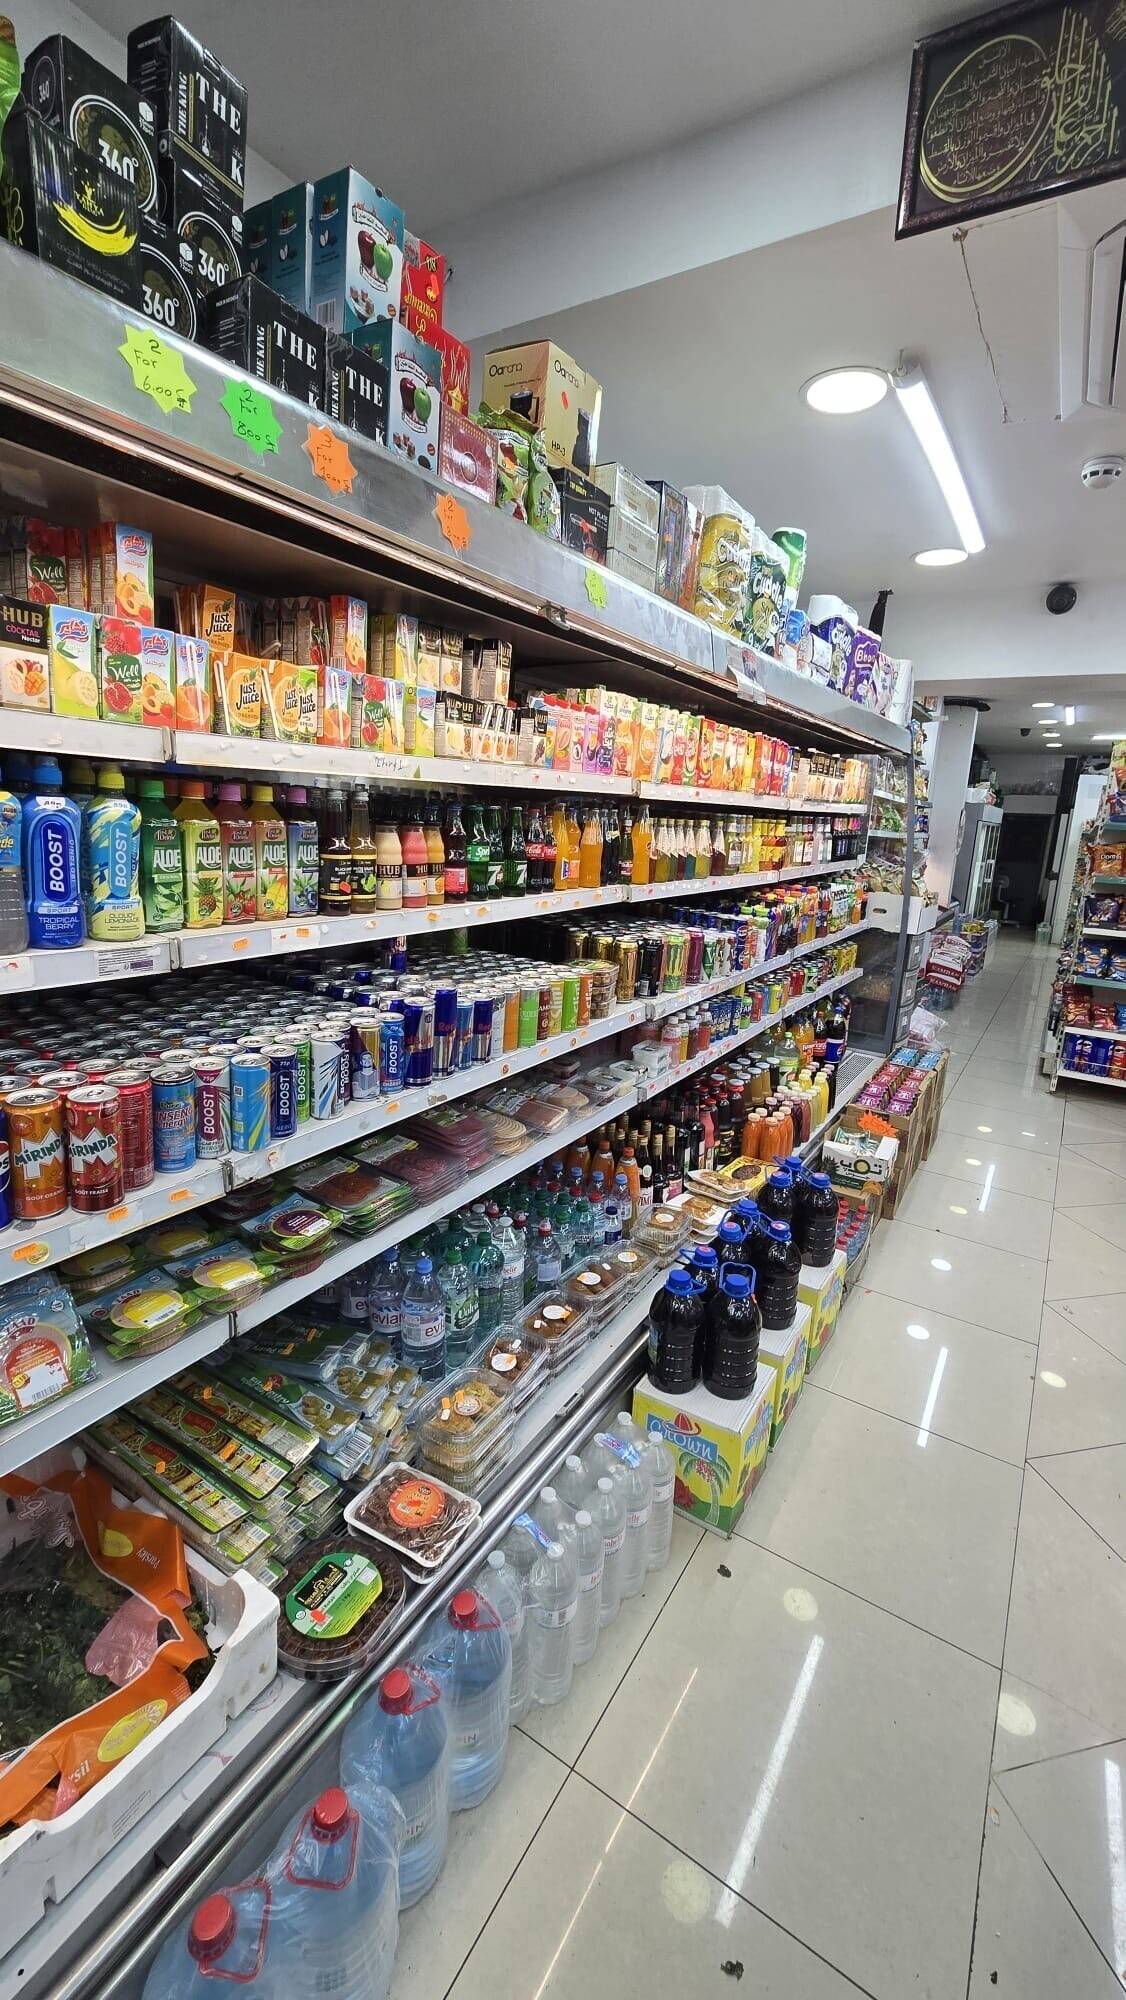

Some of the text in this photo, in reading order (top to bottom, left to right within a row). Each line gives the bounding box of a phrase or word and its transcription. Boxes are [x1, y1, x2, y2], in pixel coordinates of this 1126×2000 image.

[195, 71, 241, 136] THE
[197, 248, 229, 288] 360°
[141, 284, 181, 329] 360°
[149, 339, 162, 355] 2
[273, 320, 317, 370] THE
[134, 349, 158, 369] For
[242, 389, 254, 404] 2
[346, 365, 383, 407] THE
[32, 566, 64, 580] Well
[3, 605, 44, 628] HUB
[210, 611, 230, 628] Just
[205, 621, 233, 637] Juice
[109, 666, 140, 682] Well
[236, 692, 260, 711] Juice
[47, 829, 66, 893] BOOST
[115, 829, 128, 887] BOOST
[153, 848, 182, 870] ALOE
[196, 845, 221, 867] ALOE
[229, 846, 255, 867] ALOE
[263, 844, 287, 864] ALOE
[298, 844, 319, 863] ALOE
[380, 865, 400, 875] HUB
[46, 923, 76, 931] BERRY
[389, 1038, 398, 1074] BOOST
[297, 1063, 306, 1101] BOOST
[279, 1075, 290, 1117] BOOST
[203, 1091, 215, 1134] BOOST
